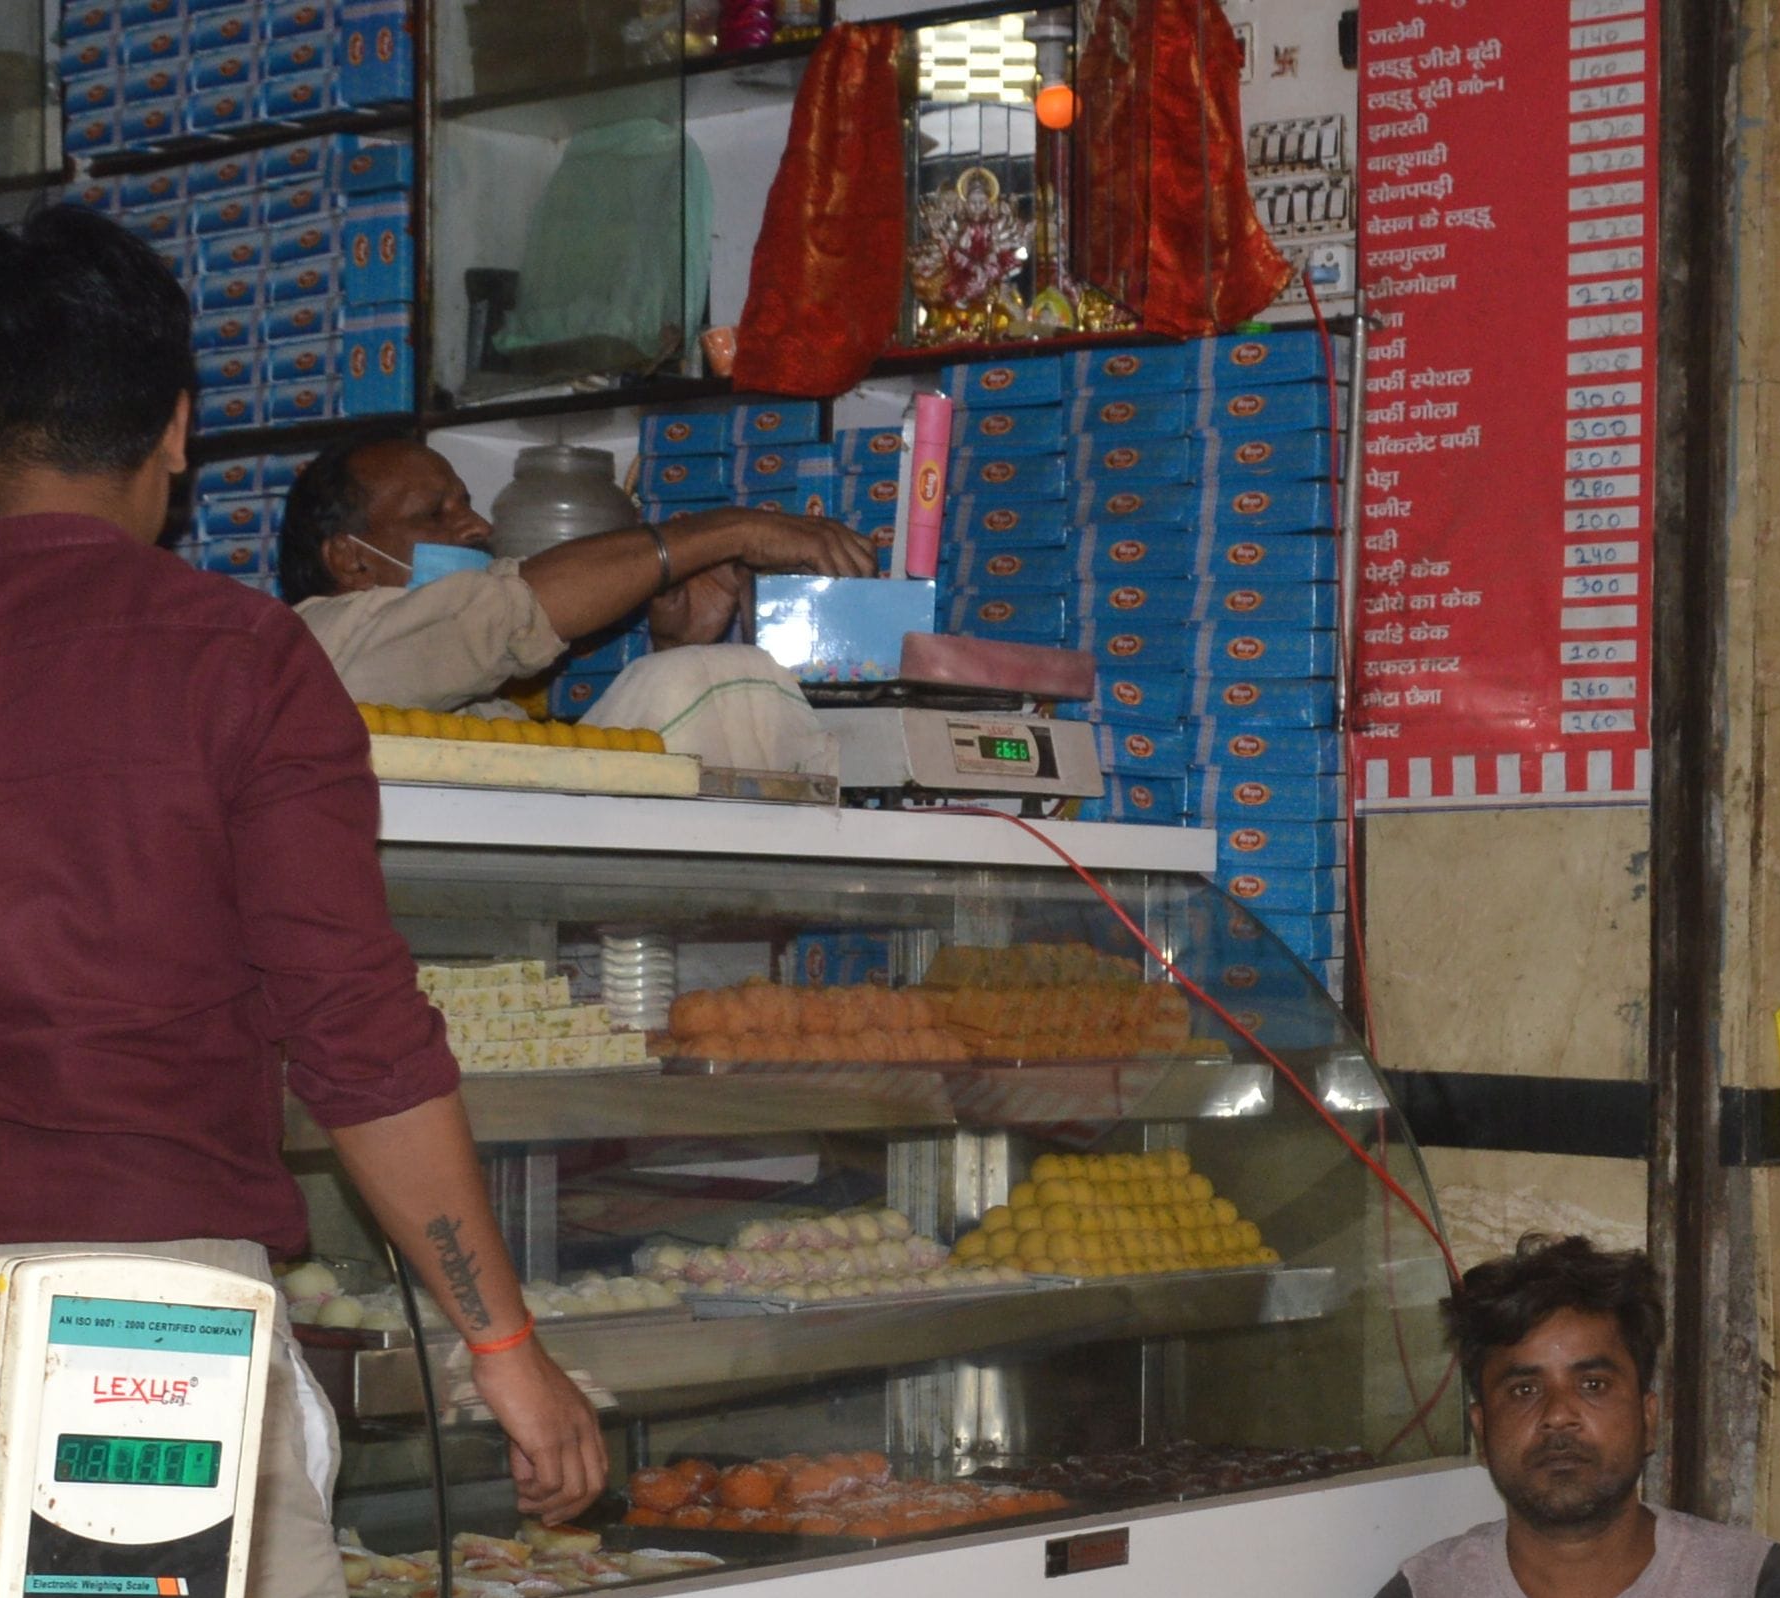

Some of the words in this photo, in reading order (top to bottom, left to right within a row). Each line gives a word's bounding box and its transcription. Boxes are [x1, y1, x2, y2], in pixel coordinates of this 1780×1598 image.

[1368, 17, 1425, 44] जलेबी
[1368, 113, 1428, 142] इमरती
[1367, 142, 1447, 176] बालूशाही
[1367, 214, 1413, 234] बेसन
[1419, 208, 1440, 228] के
[1366, 243, 1447, 271] रसगुल्ला
[1367, 273, 1457, 299] खीरमोहन
[1576, 284, 1639, 304] 220
[1410, 367, 1472, 390] स्पेशल
[1410, 400, 1458, 420] गोला
[1574, 390, 1625, 409] 300
[1572, 420, 1627, 440] 300
[1366, 432, 1437, 455] चॉकलेट
[1571, 450, 1621, 470] 300
[1572, 479, 1615, 498] 280
[1365, 496, 1412, 518] पनीर
[1365, 528, 1398, 551] दही
[1574, 547, 1617, 565] 240
[1411, 558, 1451, 578] केक
[1574, 576, 1619, 595] 300
[1410, 594, 1437, 609] का
[1441, 587, 1483, 608] केक
[1409, 621, 1450, 641] केक
[75, 1317, 91, 1327] ISO
[148, 1322, 196, 1334] CERTIFIED
[94, 1376, 188, 1402] LEXUS
[33, 1579, 78, 1590] Electronic
[81, 1580, 122, 1592] Weighing
[125, 1581, 150, 1592] Scale
